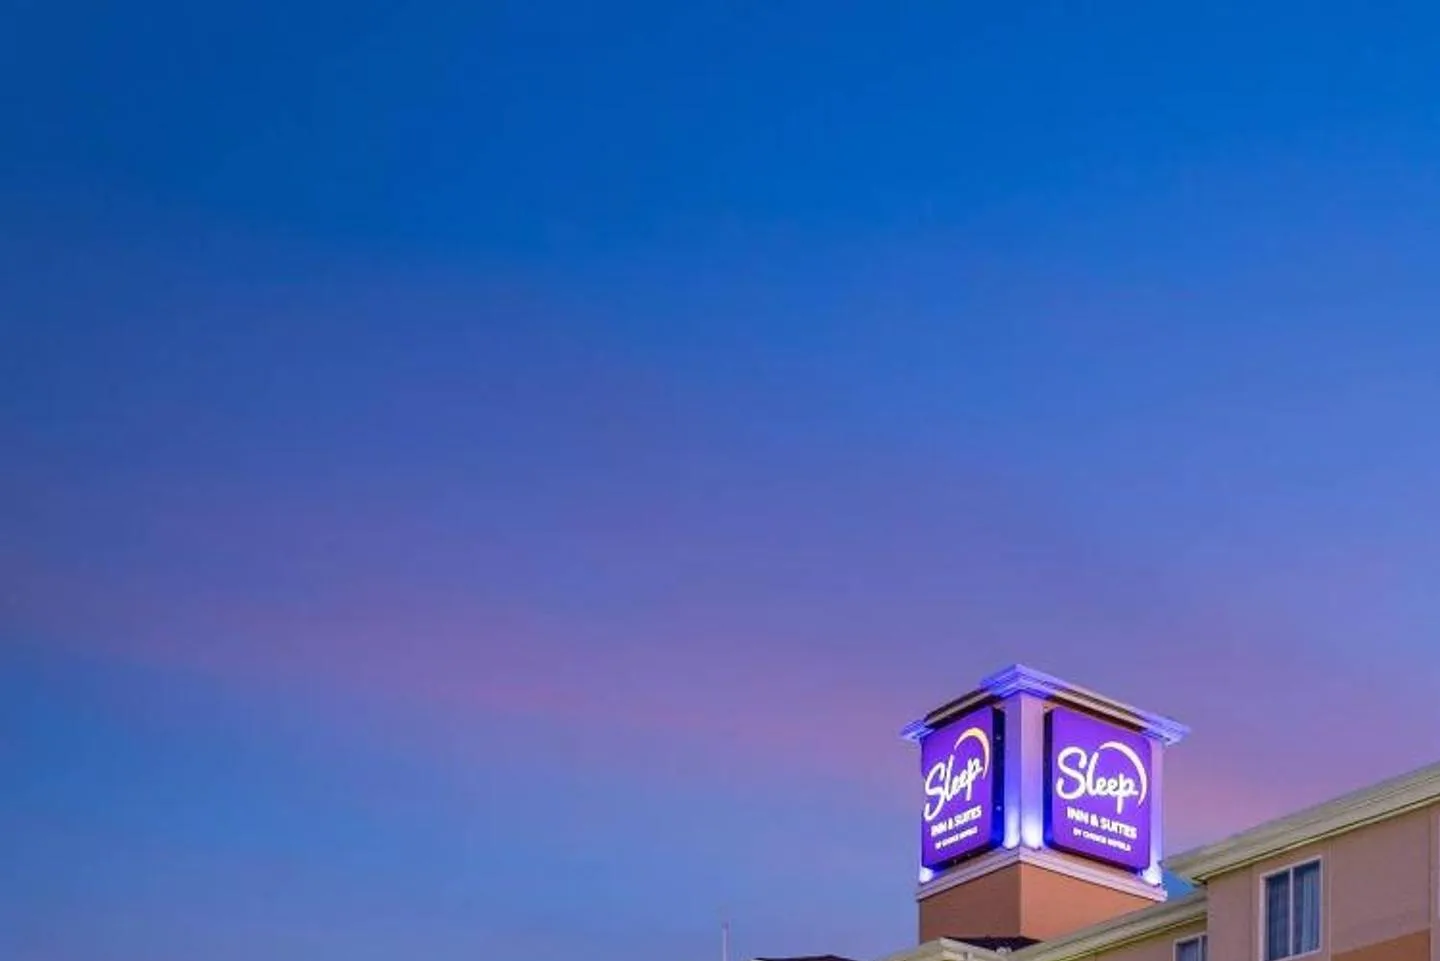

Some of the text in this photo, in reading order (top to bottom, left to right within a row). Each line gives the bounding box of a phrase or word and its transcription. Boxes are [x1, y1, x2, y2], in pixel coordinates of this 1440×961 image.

[924, 754, 983, 821] Sleep
[1056, 747, 1139, 815] Sleep
[1067, 806, 1089, 825] INN
[1100, 817, 1137, 839] SUITES
